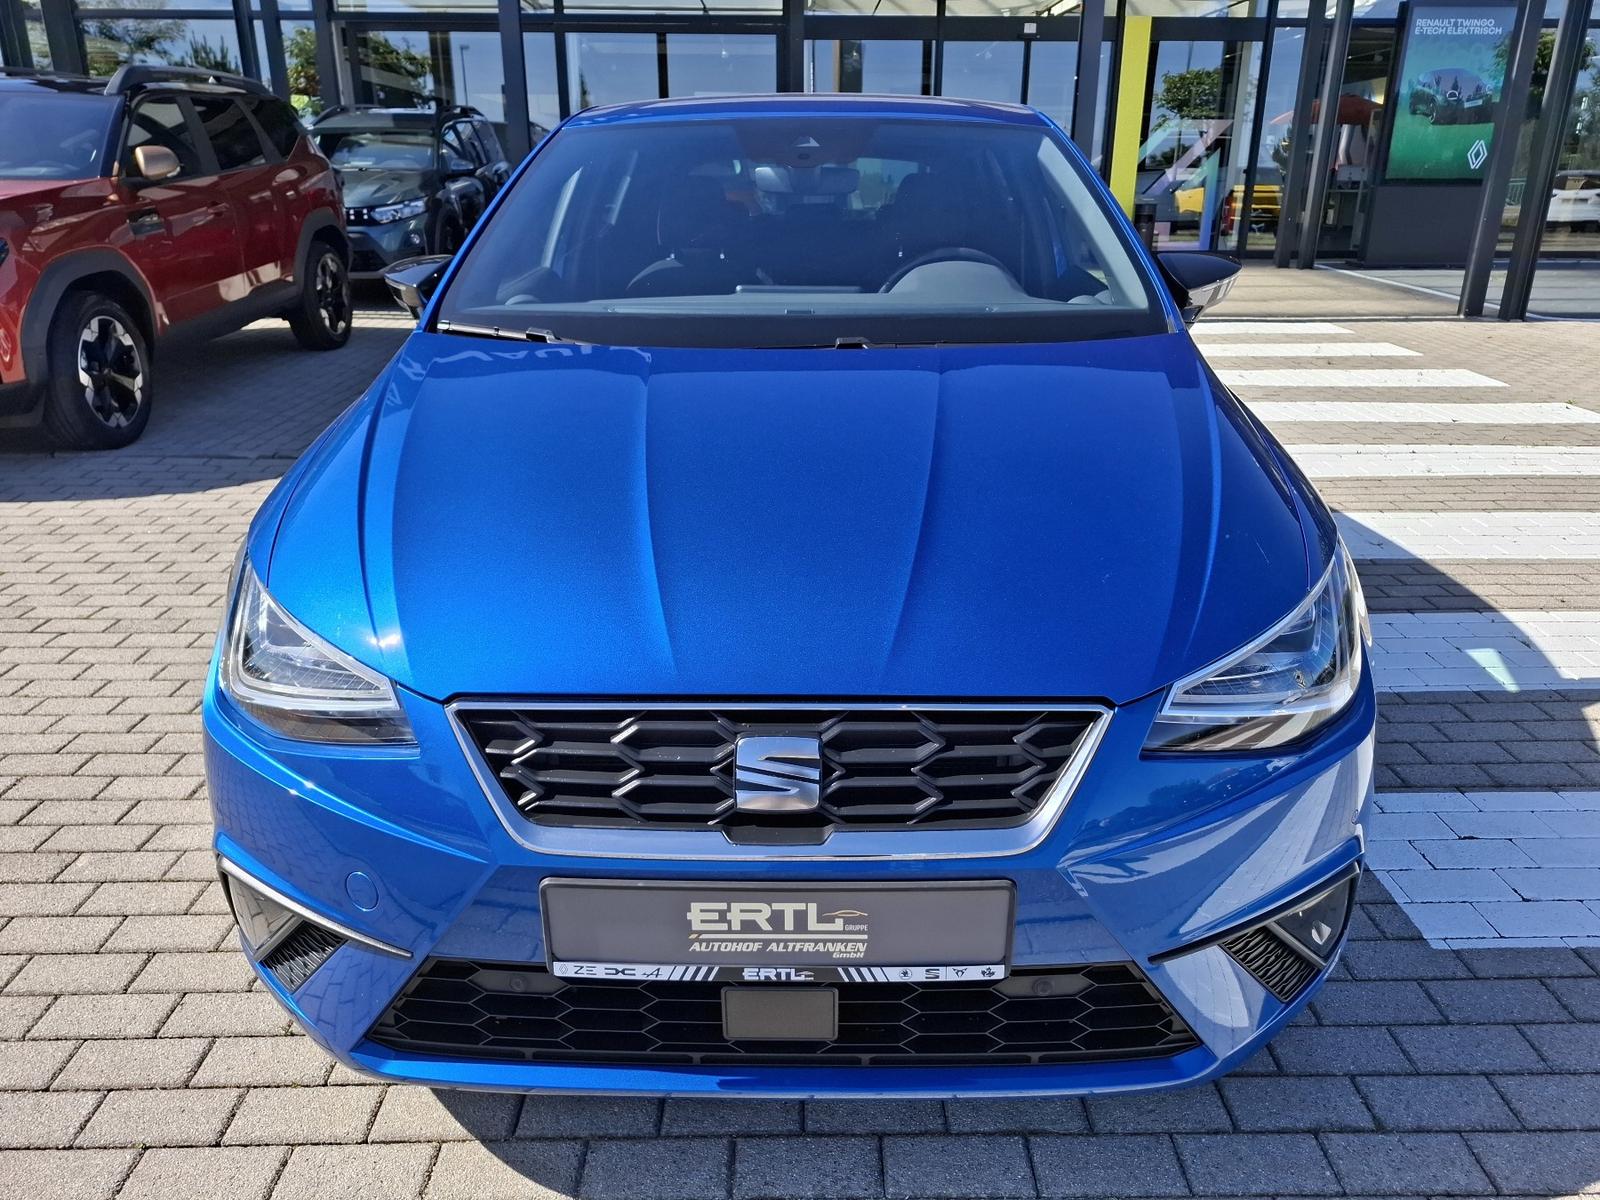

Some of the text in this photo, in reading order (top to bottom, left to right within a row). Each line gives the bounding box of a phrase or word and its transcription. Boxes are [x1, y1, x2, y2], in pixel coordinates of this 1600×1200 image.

[1416, 18, 1495, 27] RENAULT TWINGO
[1415, 26, 1503, 35] E-TECH ELEKTRISCH
[687, 902, 843, 931] ERTL
[689, 941, 868, 952] AUTOHOF ALTFRANKEN
[832, 951, 864, 959] GmbH
[742, 966, 804, 980] ERTL
